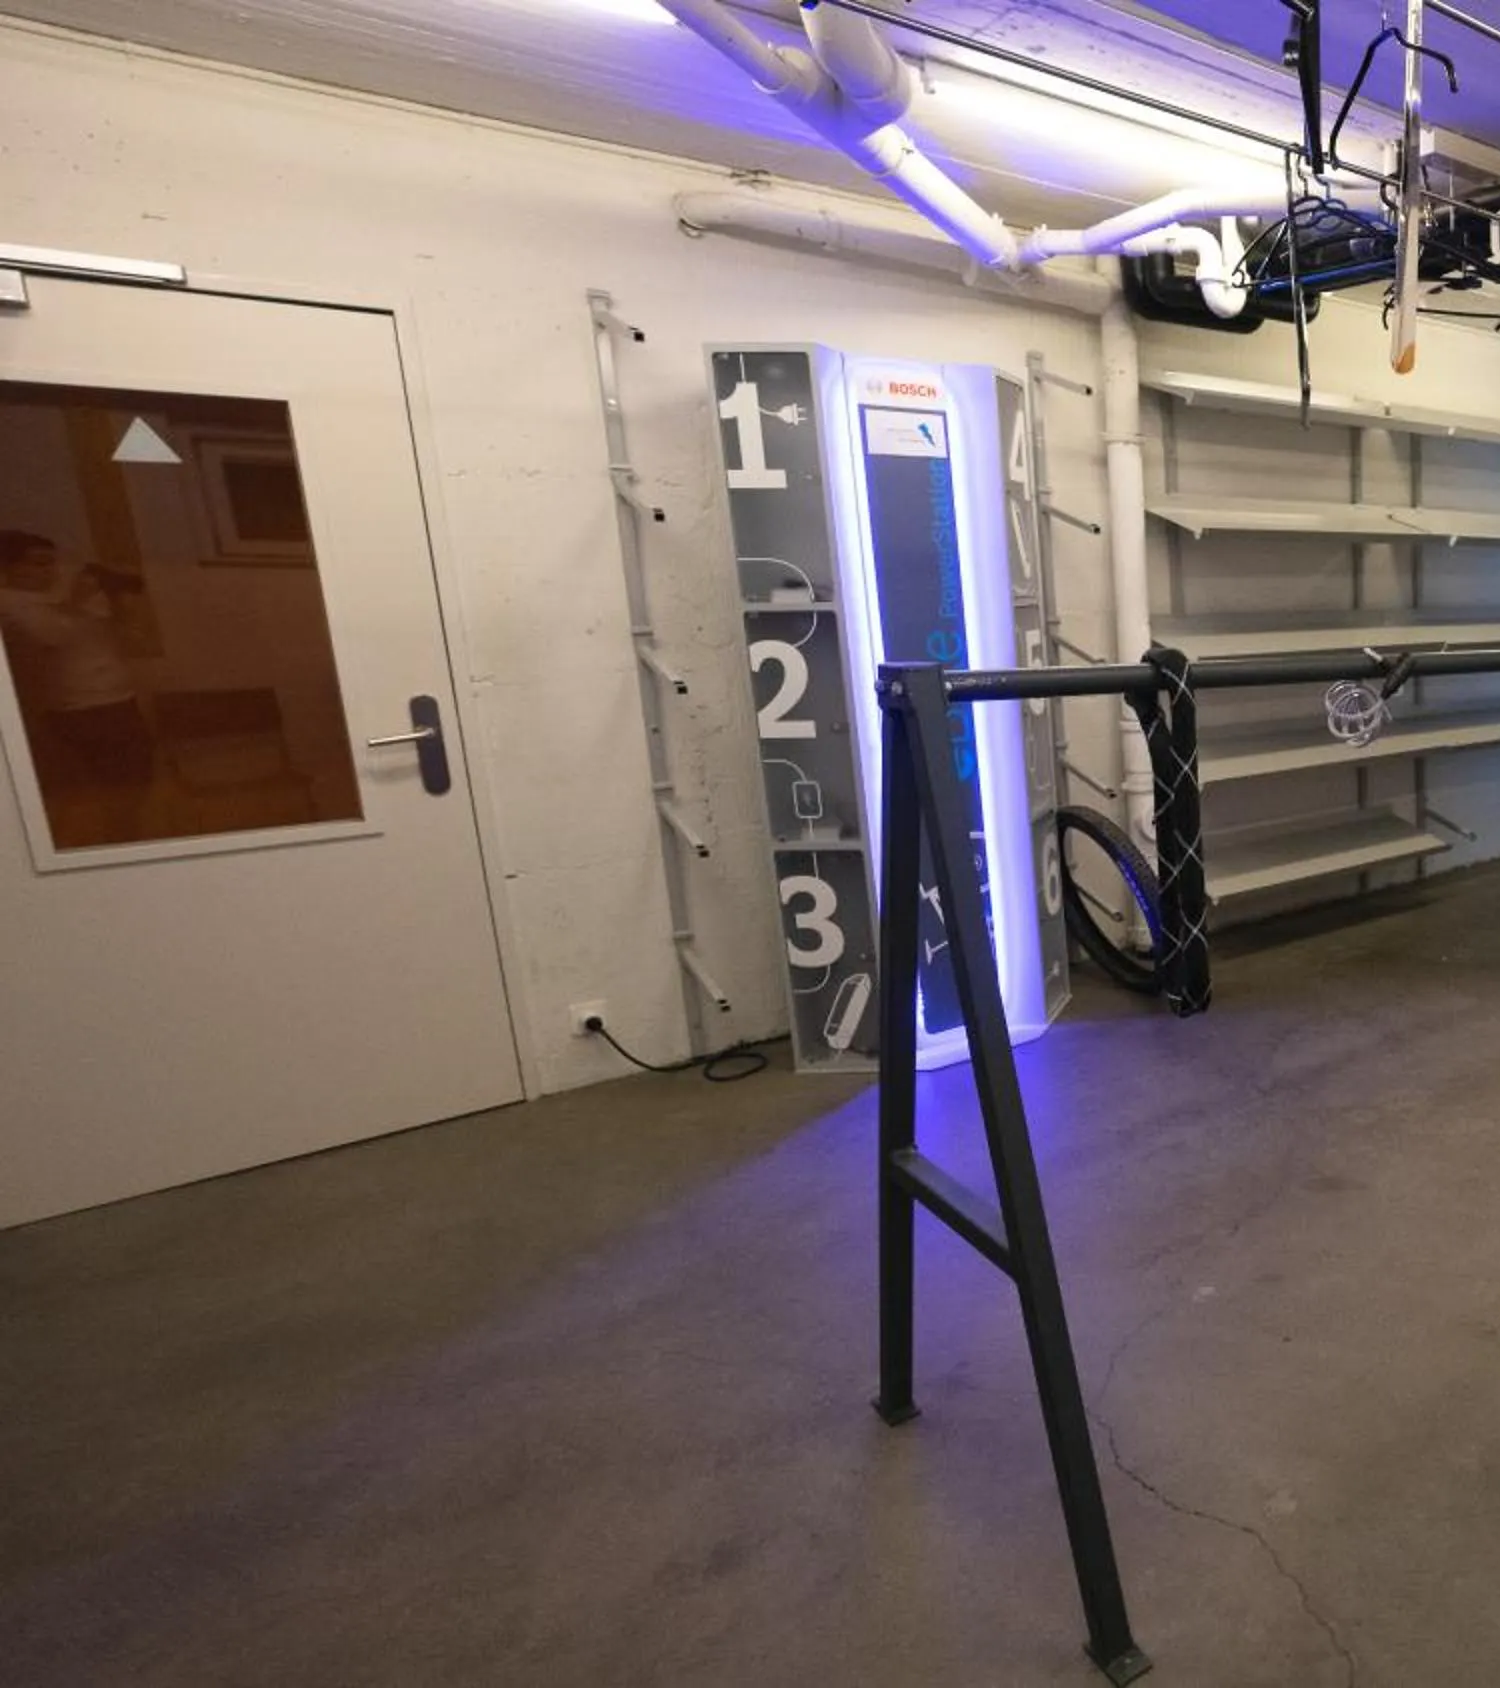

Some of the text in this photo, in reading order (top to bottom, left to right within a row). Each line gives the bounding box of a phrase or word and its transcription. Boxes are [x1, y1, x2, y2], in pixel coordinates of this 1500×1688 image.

[888, 381, 937, 399] BOSCH
[719, 381, 789, 490] 1
[1010, 411, 1031, 499] 4
[750, 640, 816, 740] 2
[780, 876, 845, 968] 3
[1042, 837, 1062, 917] 6
